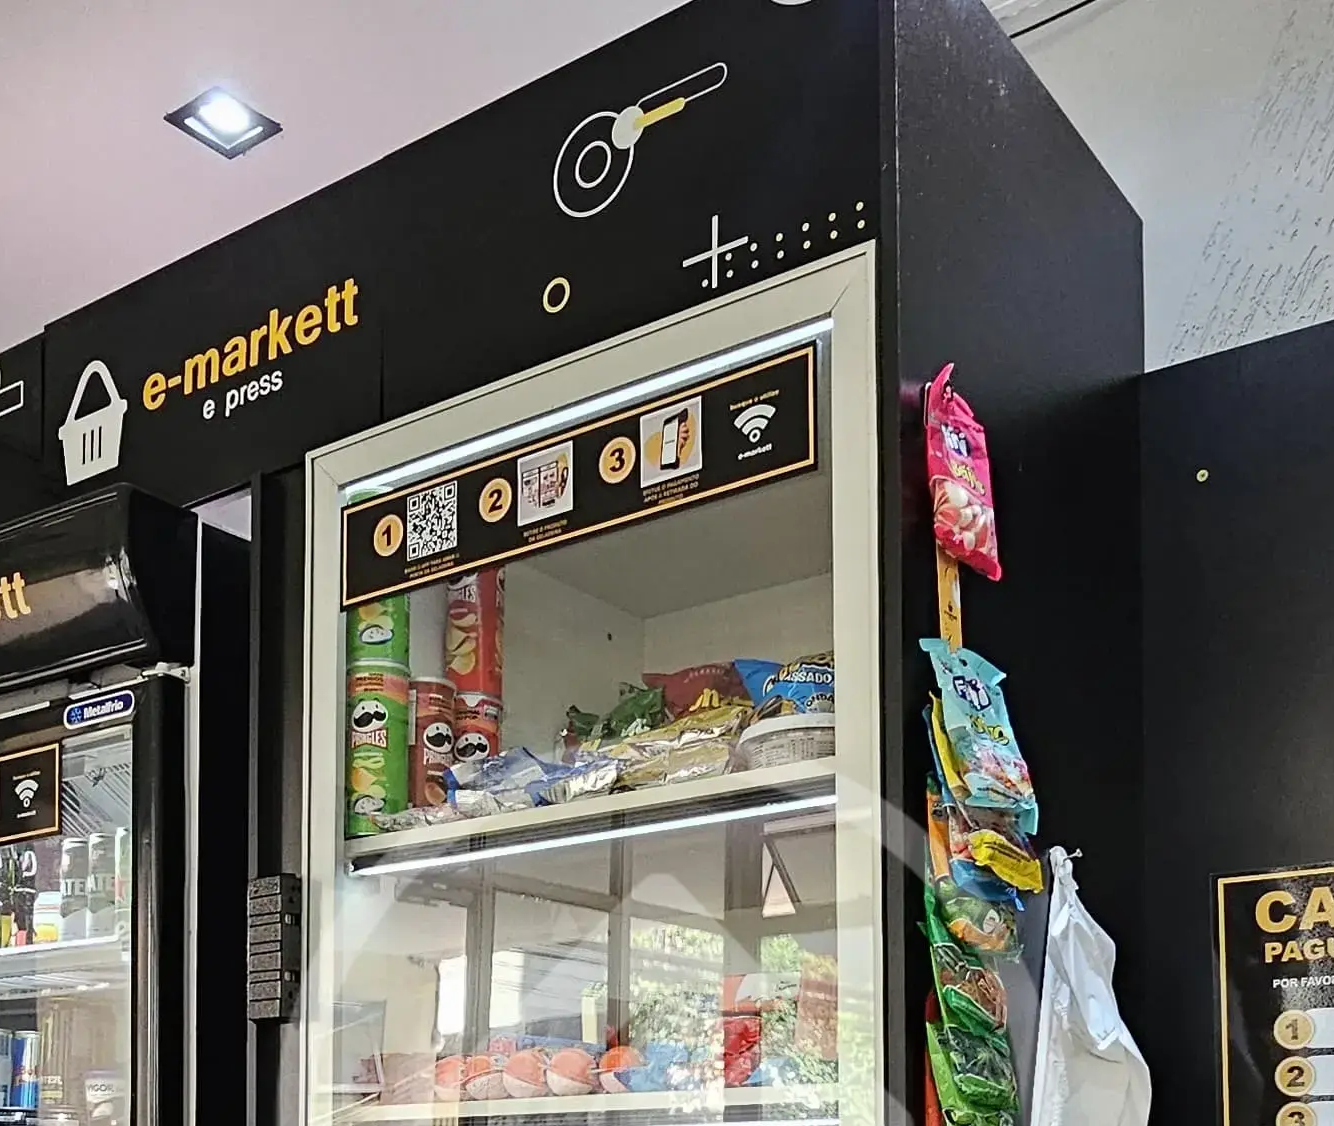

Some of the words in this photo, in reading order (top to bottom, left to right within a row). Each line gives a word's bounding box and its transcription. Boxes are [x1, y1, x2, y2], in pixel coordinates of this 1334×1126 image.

[141, 276, 359, 412] e-markett
[609, 447, 625, 473] 3
[488, 489, 503, 513] 2
[382, 525, 393, 547] 1
[1272, 976, 1298, 989] POR
[1285, 1018, 1299, 1041] 1
[1286, 1066, 1306, 1088] 2
